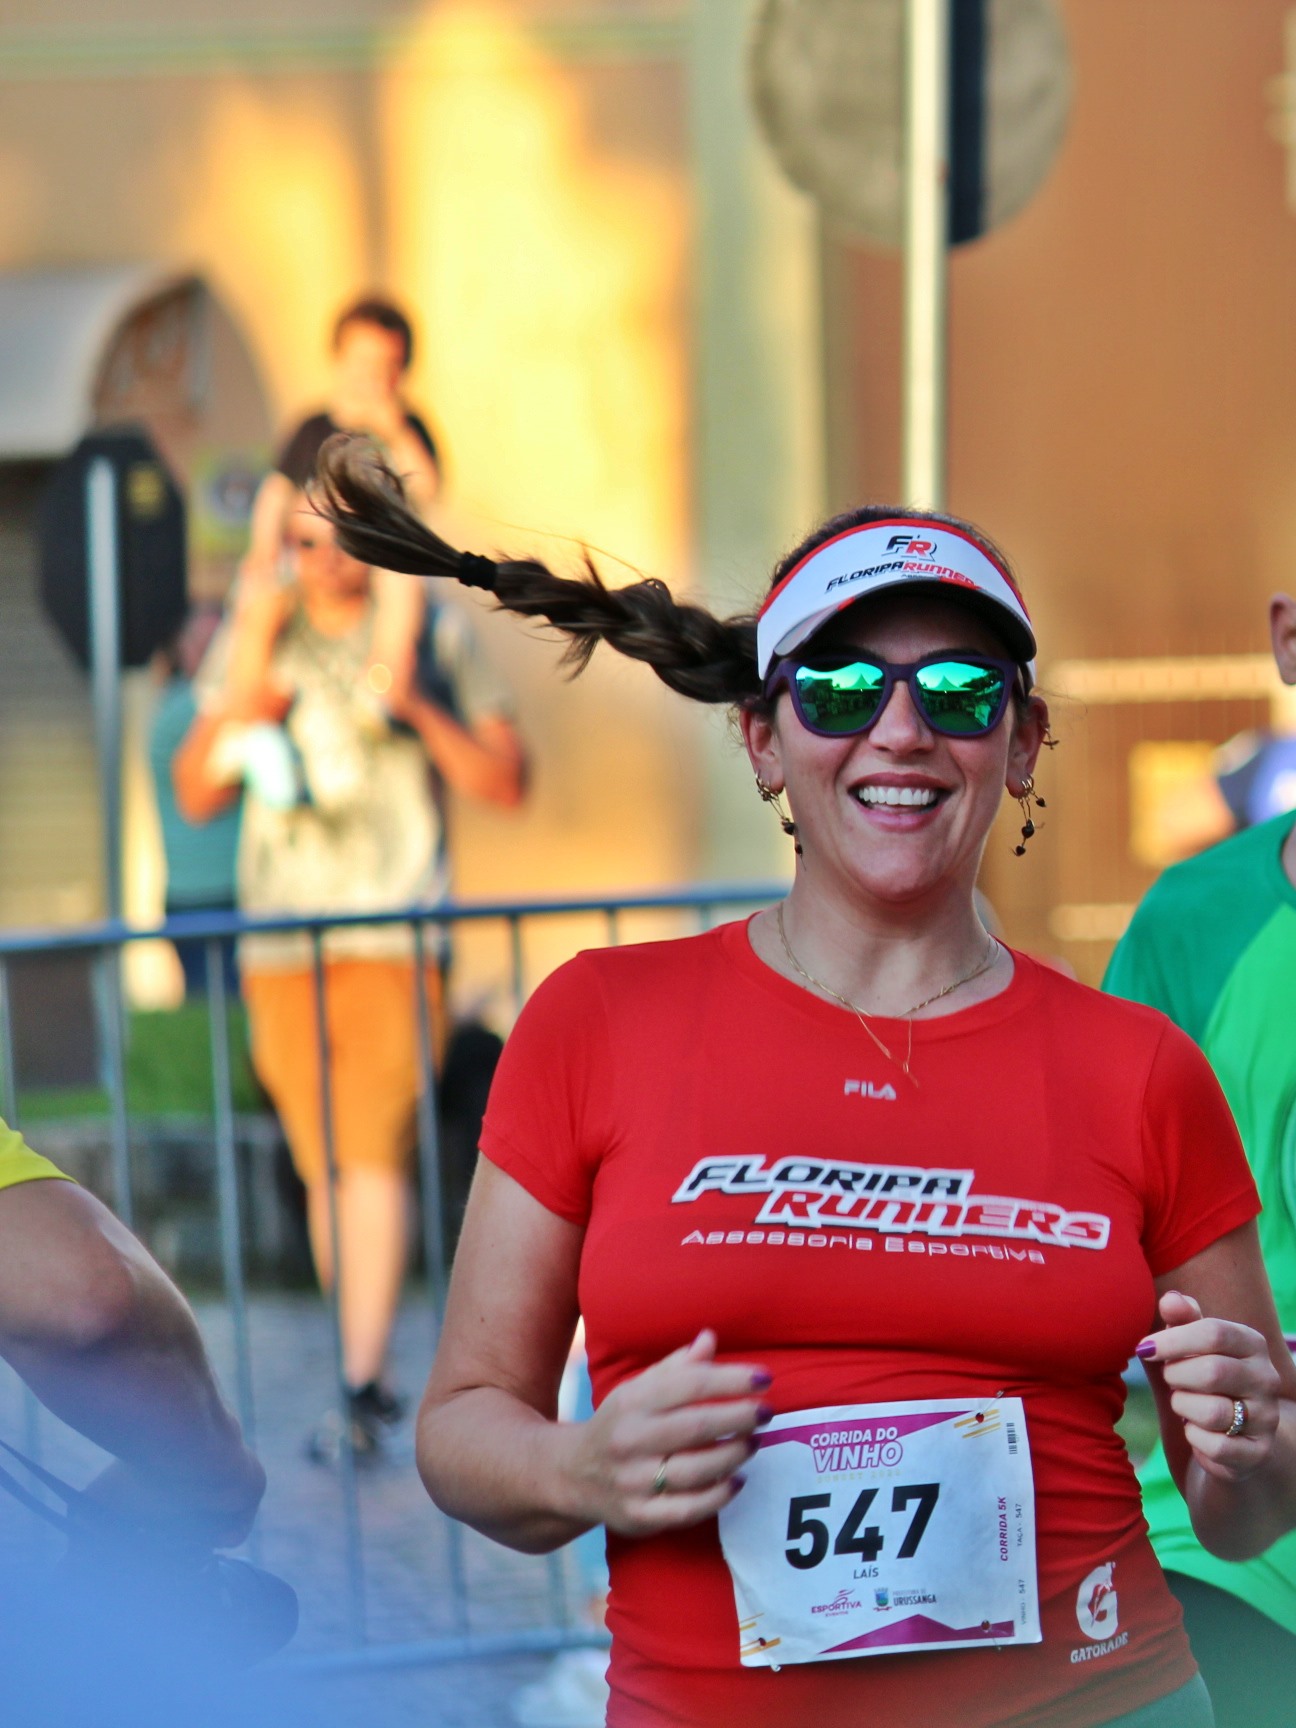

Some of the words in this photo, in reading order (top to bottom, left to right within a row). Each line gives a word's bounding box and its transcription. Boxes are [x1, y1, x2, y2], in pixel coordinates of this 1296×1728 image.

[882, 535, 937, 562] FR
[844, 1079, 896, 1100] FILA
[672, 1154, 974, 1202] FLORIPA
[755, 1189, 1110, 1249] RUNNERS
[681, 1229, 872, 1252] Assessoria
[884, 1236, 1045, 1265] Esportiva
[810, 1429, 872, 1448] CORRIDA
[875, 1426, 898, 1442] DO
[813, 1441, 904, 1474] VINHO
[997, 1496, 1007, 1510] 5K
[785, 1483, 940, 1570] 547
[998, 1513, 1008, 1562] CORRIDA
[853, 1565, 879, 1579] LAÍS
[1018, 1579, 1026, 1594] 547
[811, 1601, 862, 1614] ESPORTIVA
[893, 1594, 937, 1607] URUSSANGA
[1070, 1632, 1129, 1664] GATORADE
